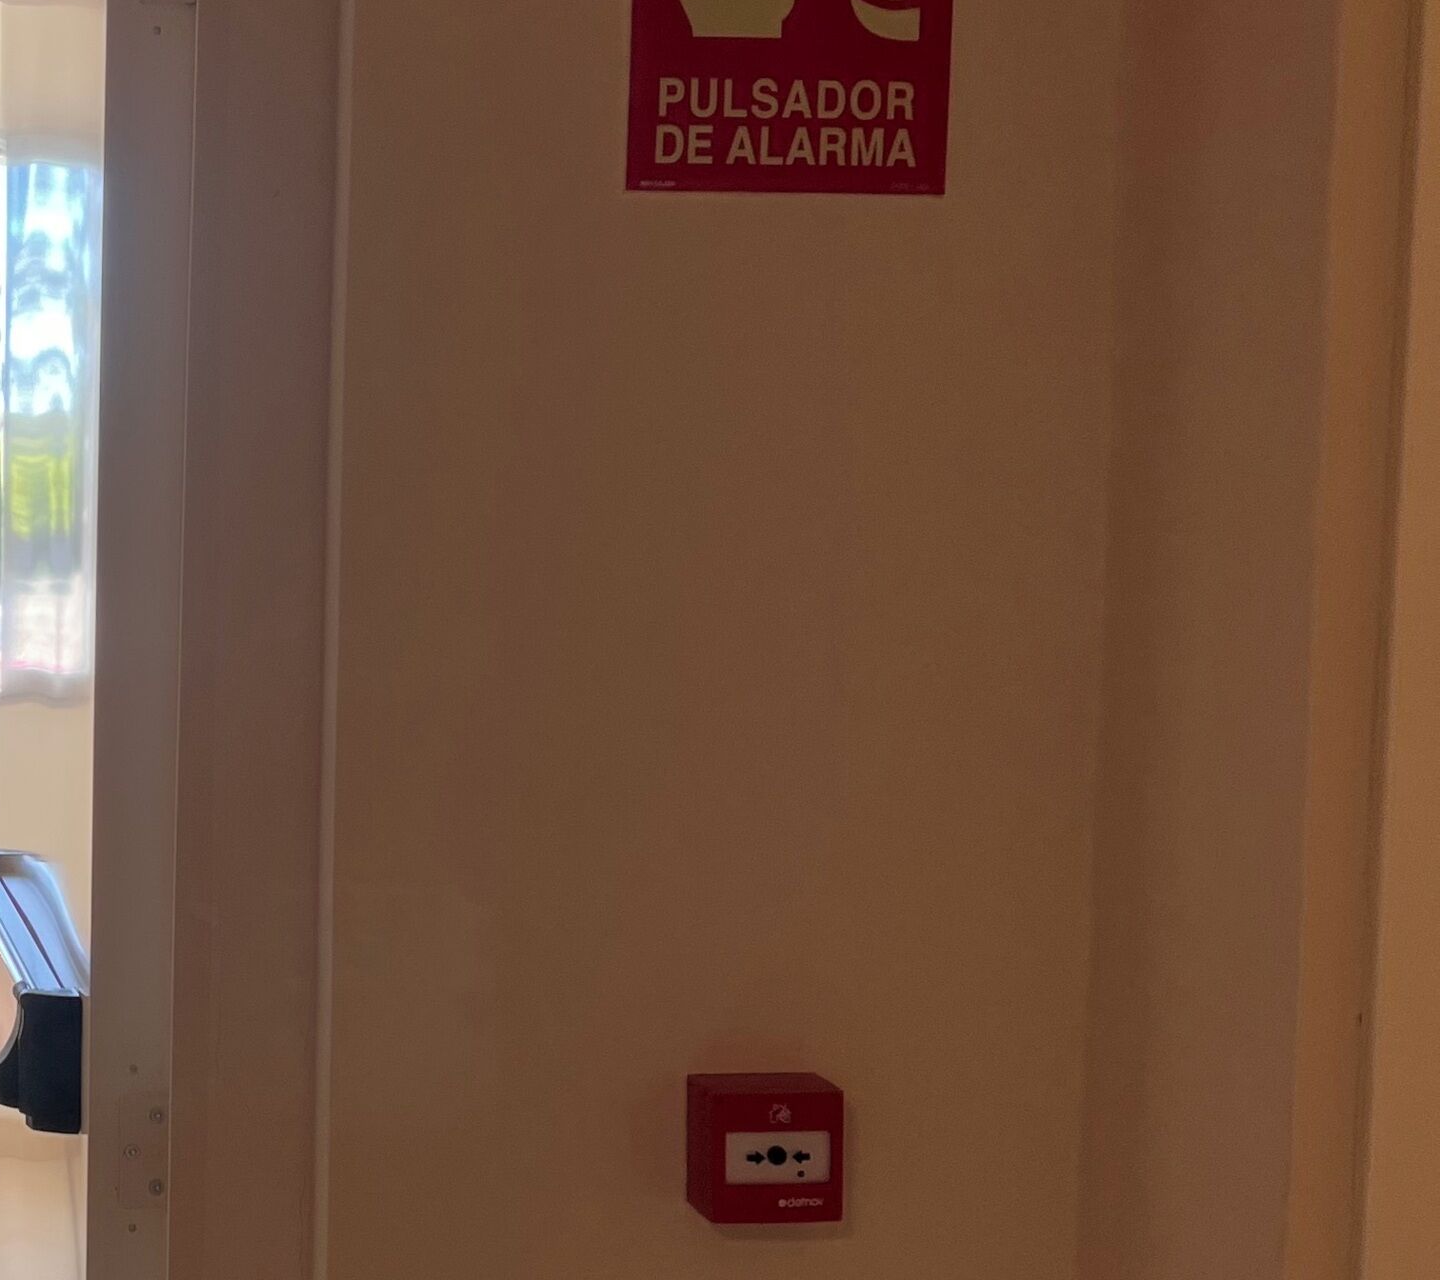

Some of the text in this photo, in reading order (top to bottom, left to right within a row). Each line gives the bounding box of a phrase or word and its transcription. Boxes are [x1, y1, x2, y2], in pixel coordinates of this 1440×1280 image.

[658, 77, 916, 121] PULSADOR
[654, 125, 917, 168] DE ALARMA
